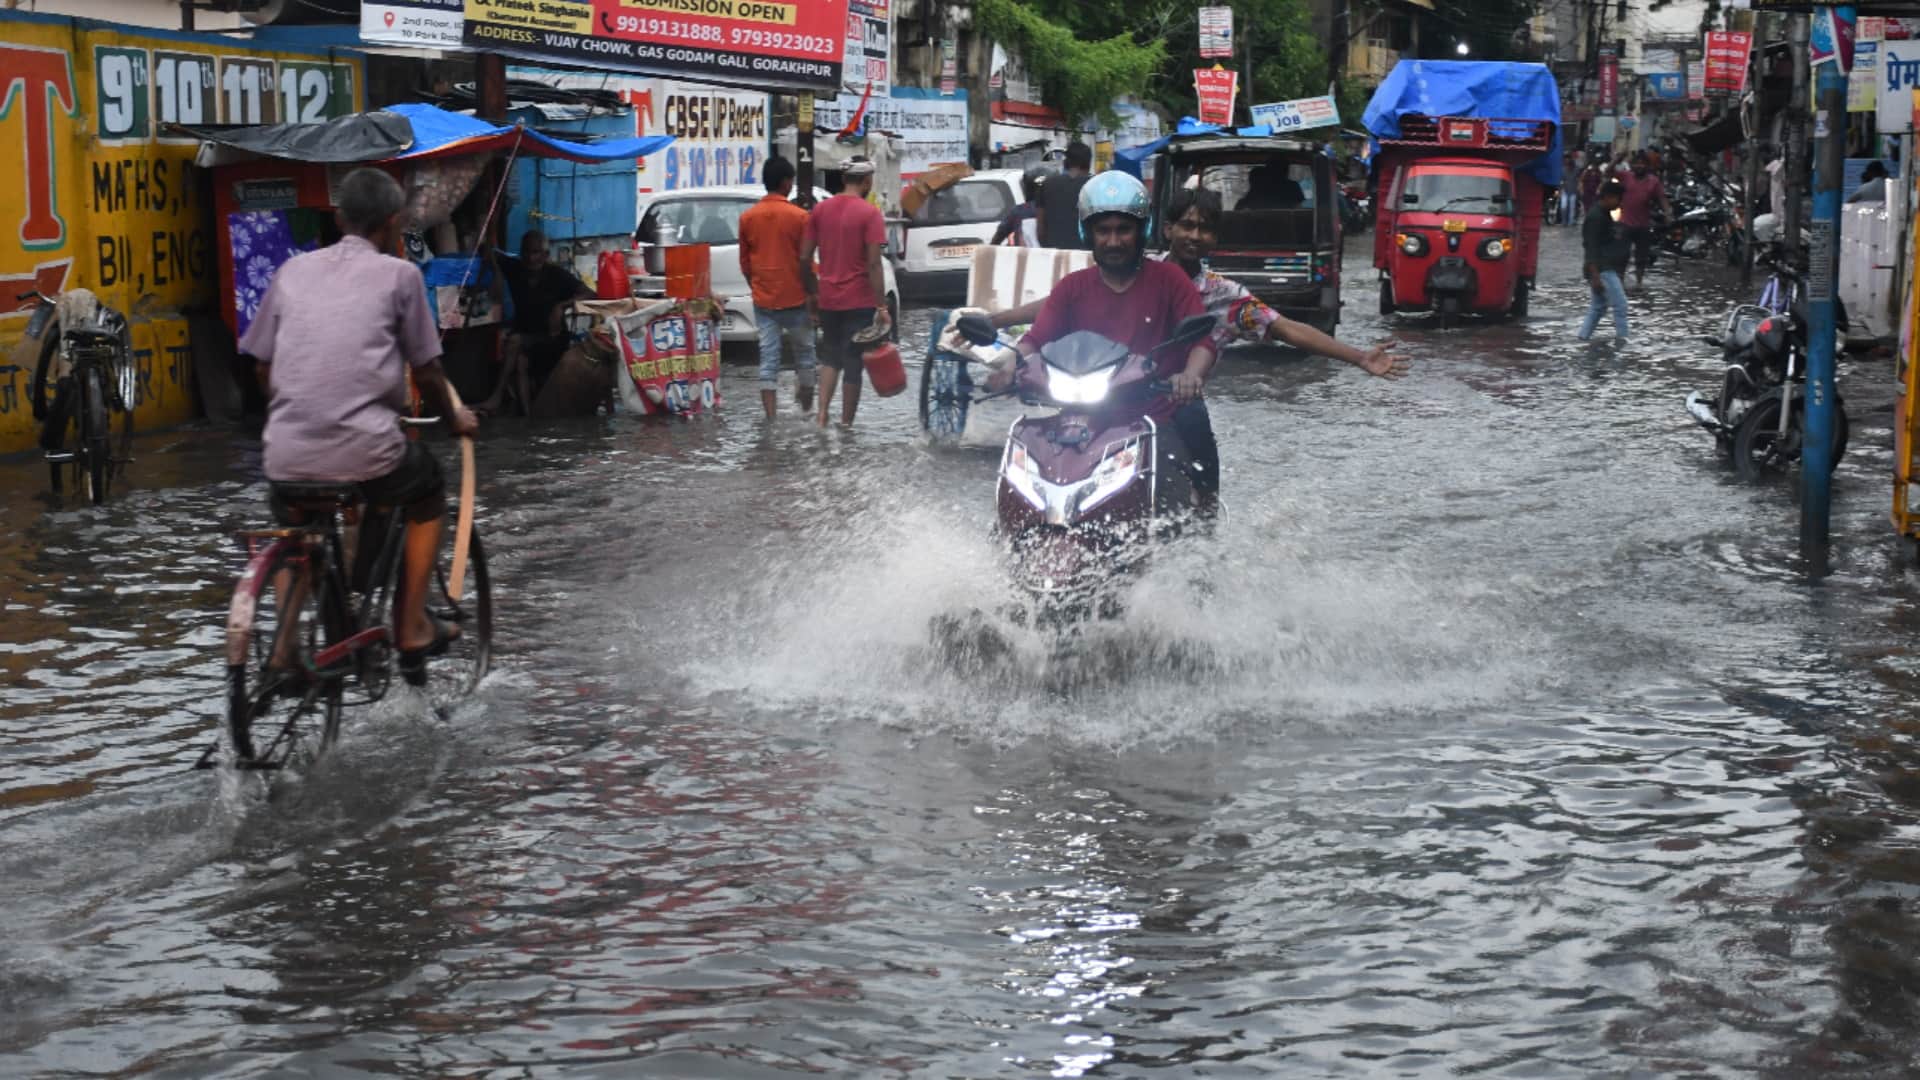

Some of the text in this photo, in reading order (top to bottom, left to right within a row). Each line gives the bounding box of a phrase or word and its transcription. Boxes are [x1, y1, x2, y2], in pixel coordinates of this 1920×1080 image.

[402, 17, 421, 27] 2nd
[738, 3, 785, 20] OPEN
[401, 29, 413, 39] 10
[415, 31, 437, 40] Park
[617, 16, 725, 43] 9919131888,
[731, 28, 834, 53] 9793923023
[473, 25, 541, 44] ADDRESS:-
[544, 33, 580, 49] VIJAY
[581, 38, 634, 57] CHOWK,
[637, 46, 664, 60] GAS
[666, 48, 715, 65] GODAM
[752, 58, 832, 78] GORAKHPUR
[101, 54, 147, 134] 9th
[156, 57, 216, 125] 10th
[223, 63, 274, 125] 11th
[665, 95, 709, 138] CBSE
[712, 96, 727, 139] UP
[728, 97, 765, 138] Board
[1276, 115, 1302, 128] JOB
